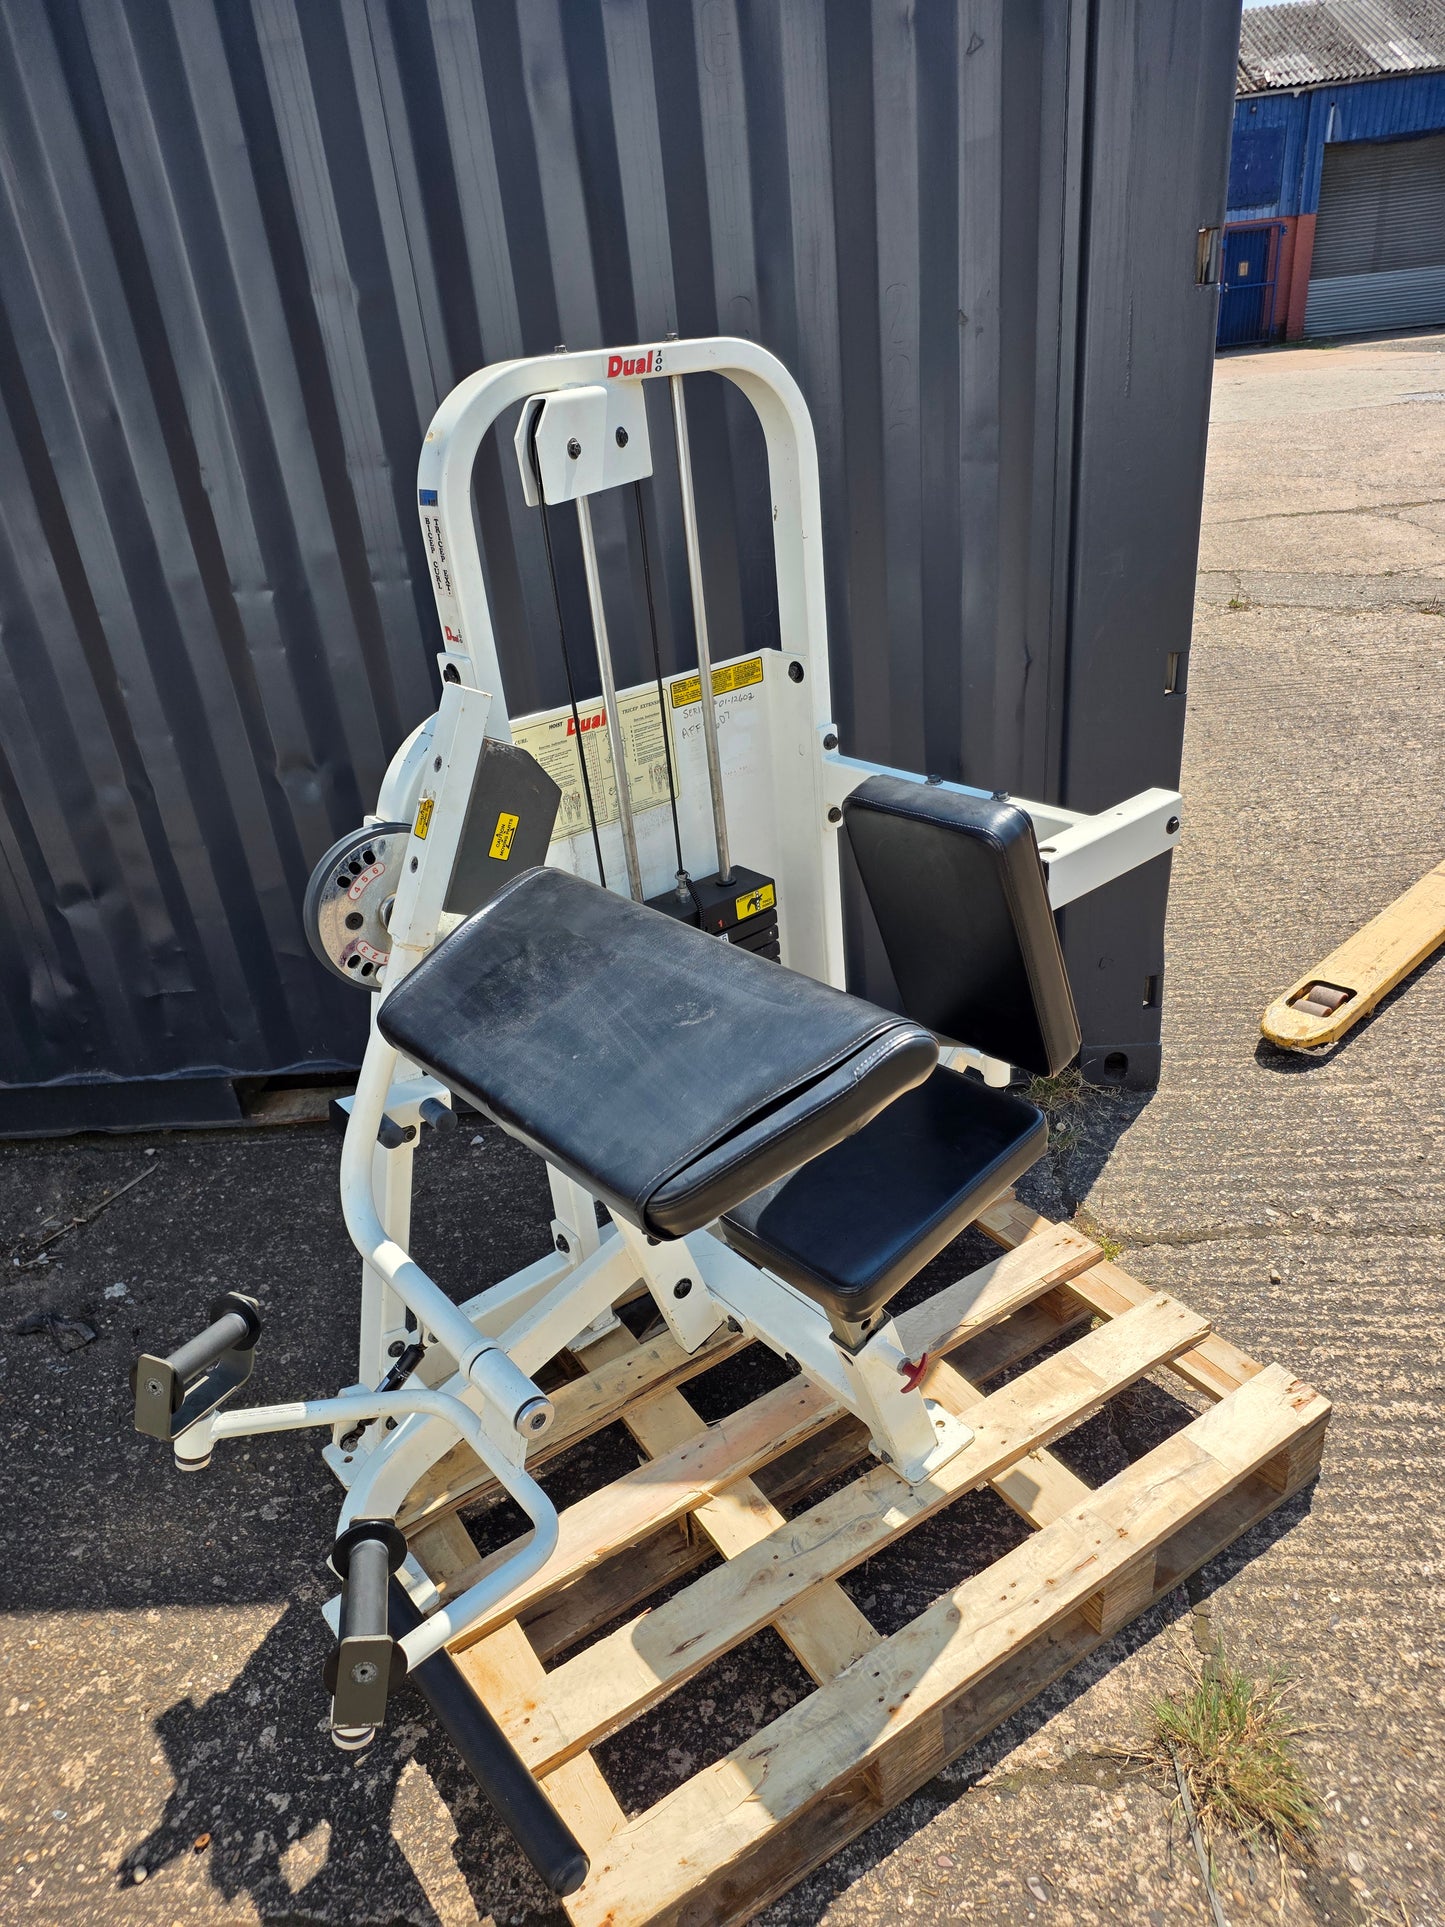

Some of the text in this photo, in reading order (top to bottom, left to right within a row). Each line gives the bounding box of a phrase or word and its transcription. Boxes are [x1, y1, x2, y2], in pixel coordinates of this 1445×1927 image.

[607, 350, 663, 378] Dual 100
[425, 517, 435, 554] BICEP
[566, 708, 607, 736] Dual
[496, 824, 505, 848] CAUTION
[500, 818, 513, 856] MOVING PARTS
[372, 867, 379, 875] 6
